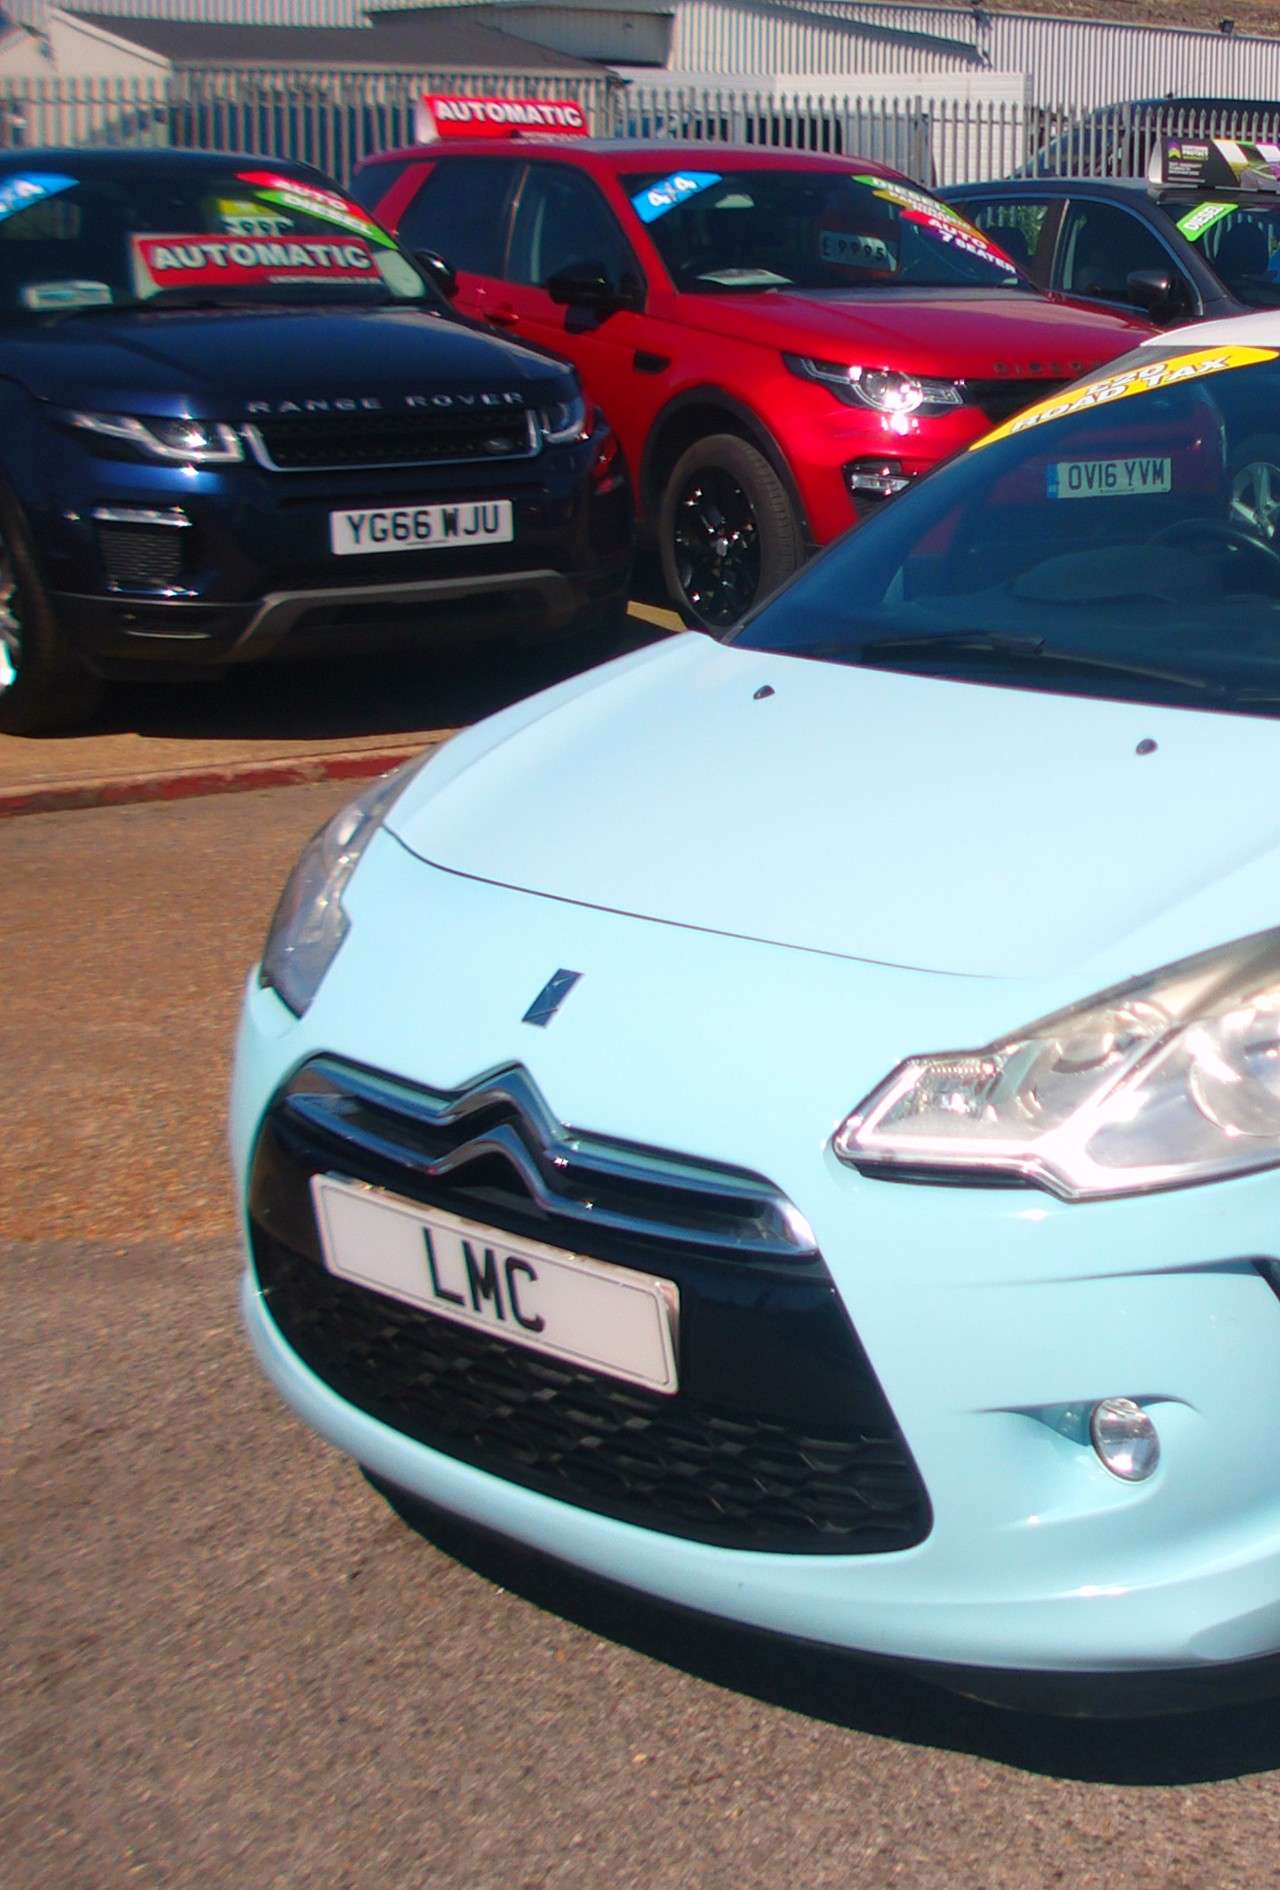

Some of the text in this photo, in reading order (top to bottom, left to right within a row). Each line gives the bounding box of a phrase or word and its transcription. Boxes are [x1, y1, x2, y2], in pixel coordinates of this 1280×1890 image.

[436, 101, 583, 127] AUTOMATIC
[928, 218, 988, 250] AUTO
[150, 239, 373, 269] AUTOMATIC
[938, 229, 1018, 274] 7 SEATER
[248, 392, 524, 413] RANGE ROVER
[1011, 355, 1231, 433] ROAD TAX
[1067, 459, 1165, 490] OV16 YVM
[346, 504, 500, 545] YG66 WJU
[422, 1226, 546, 1333] LMC
